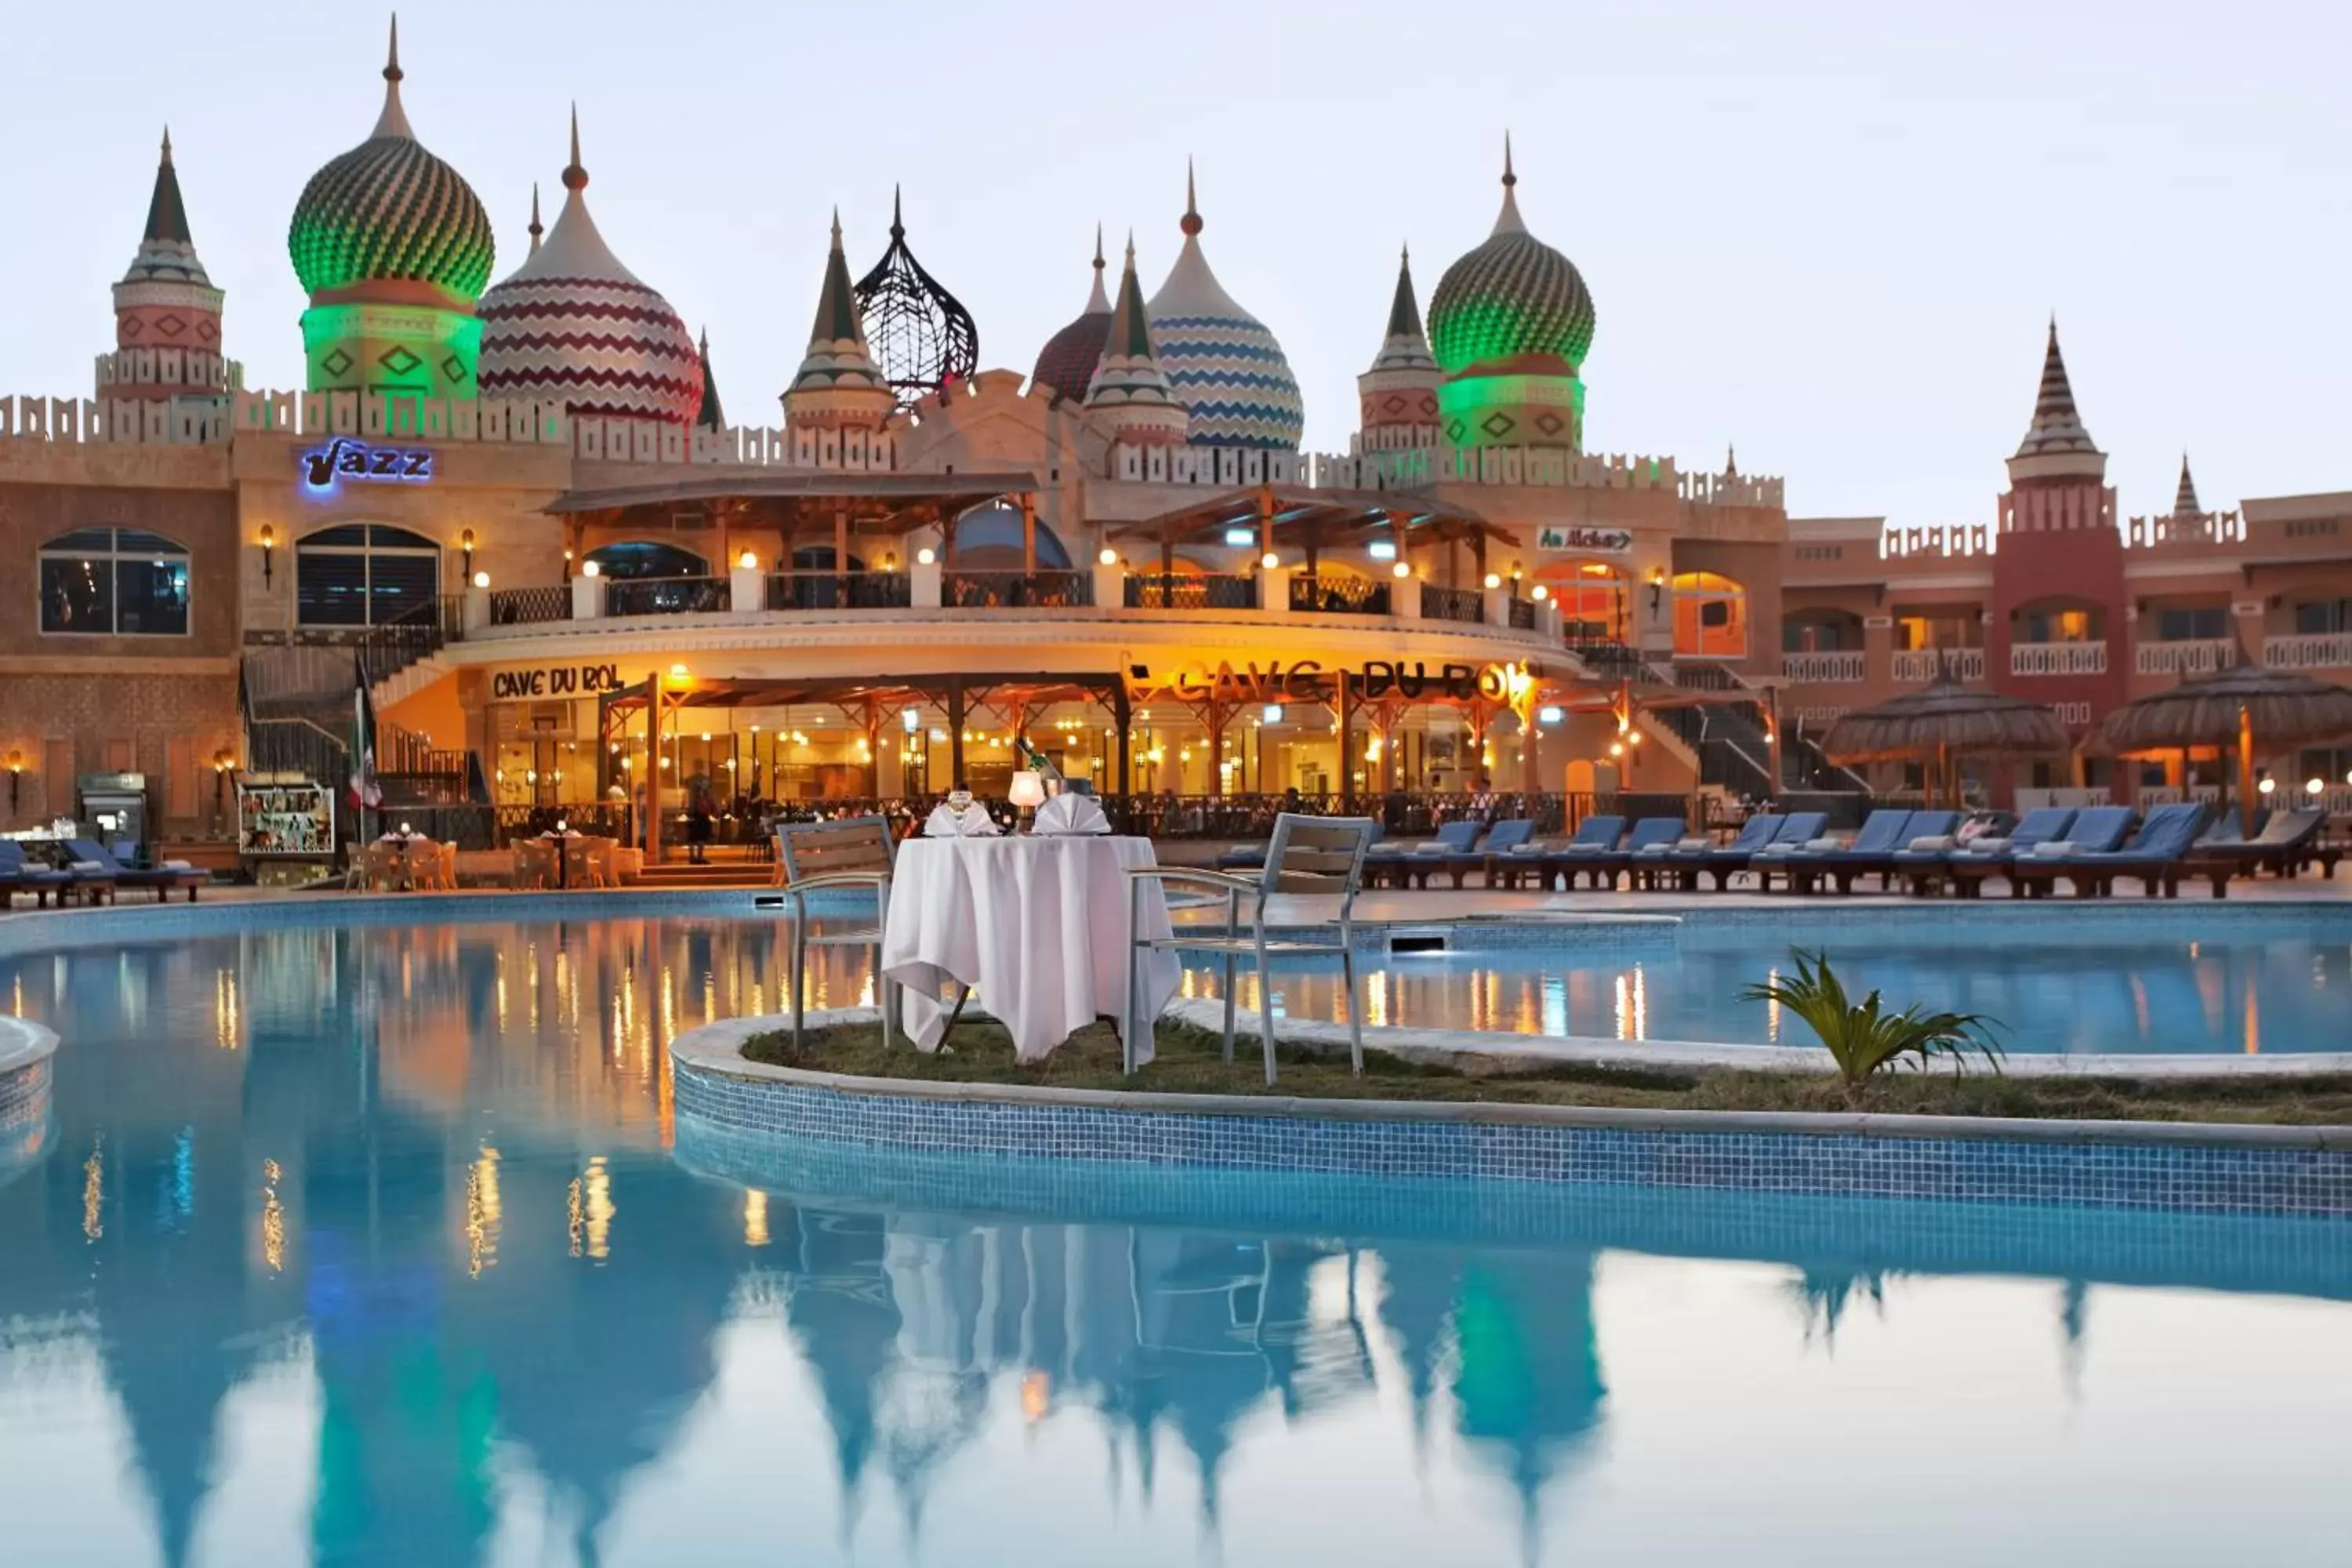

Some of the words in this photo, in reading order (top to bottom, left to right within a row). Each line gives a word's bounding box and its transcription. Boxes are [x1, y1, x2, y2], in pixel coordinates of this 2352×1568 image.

[303, 437, 431, 485] Jazz
[494, 670, 545, 698] CAVE
[550, 667, 576, 694] DU
[1174, 660, 1323, 701] CAVE
[1363, 662, 1425, 698] DU
